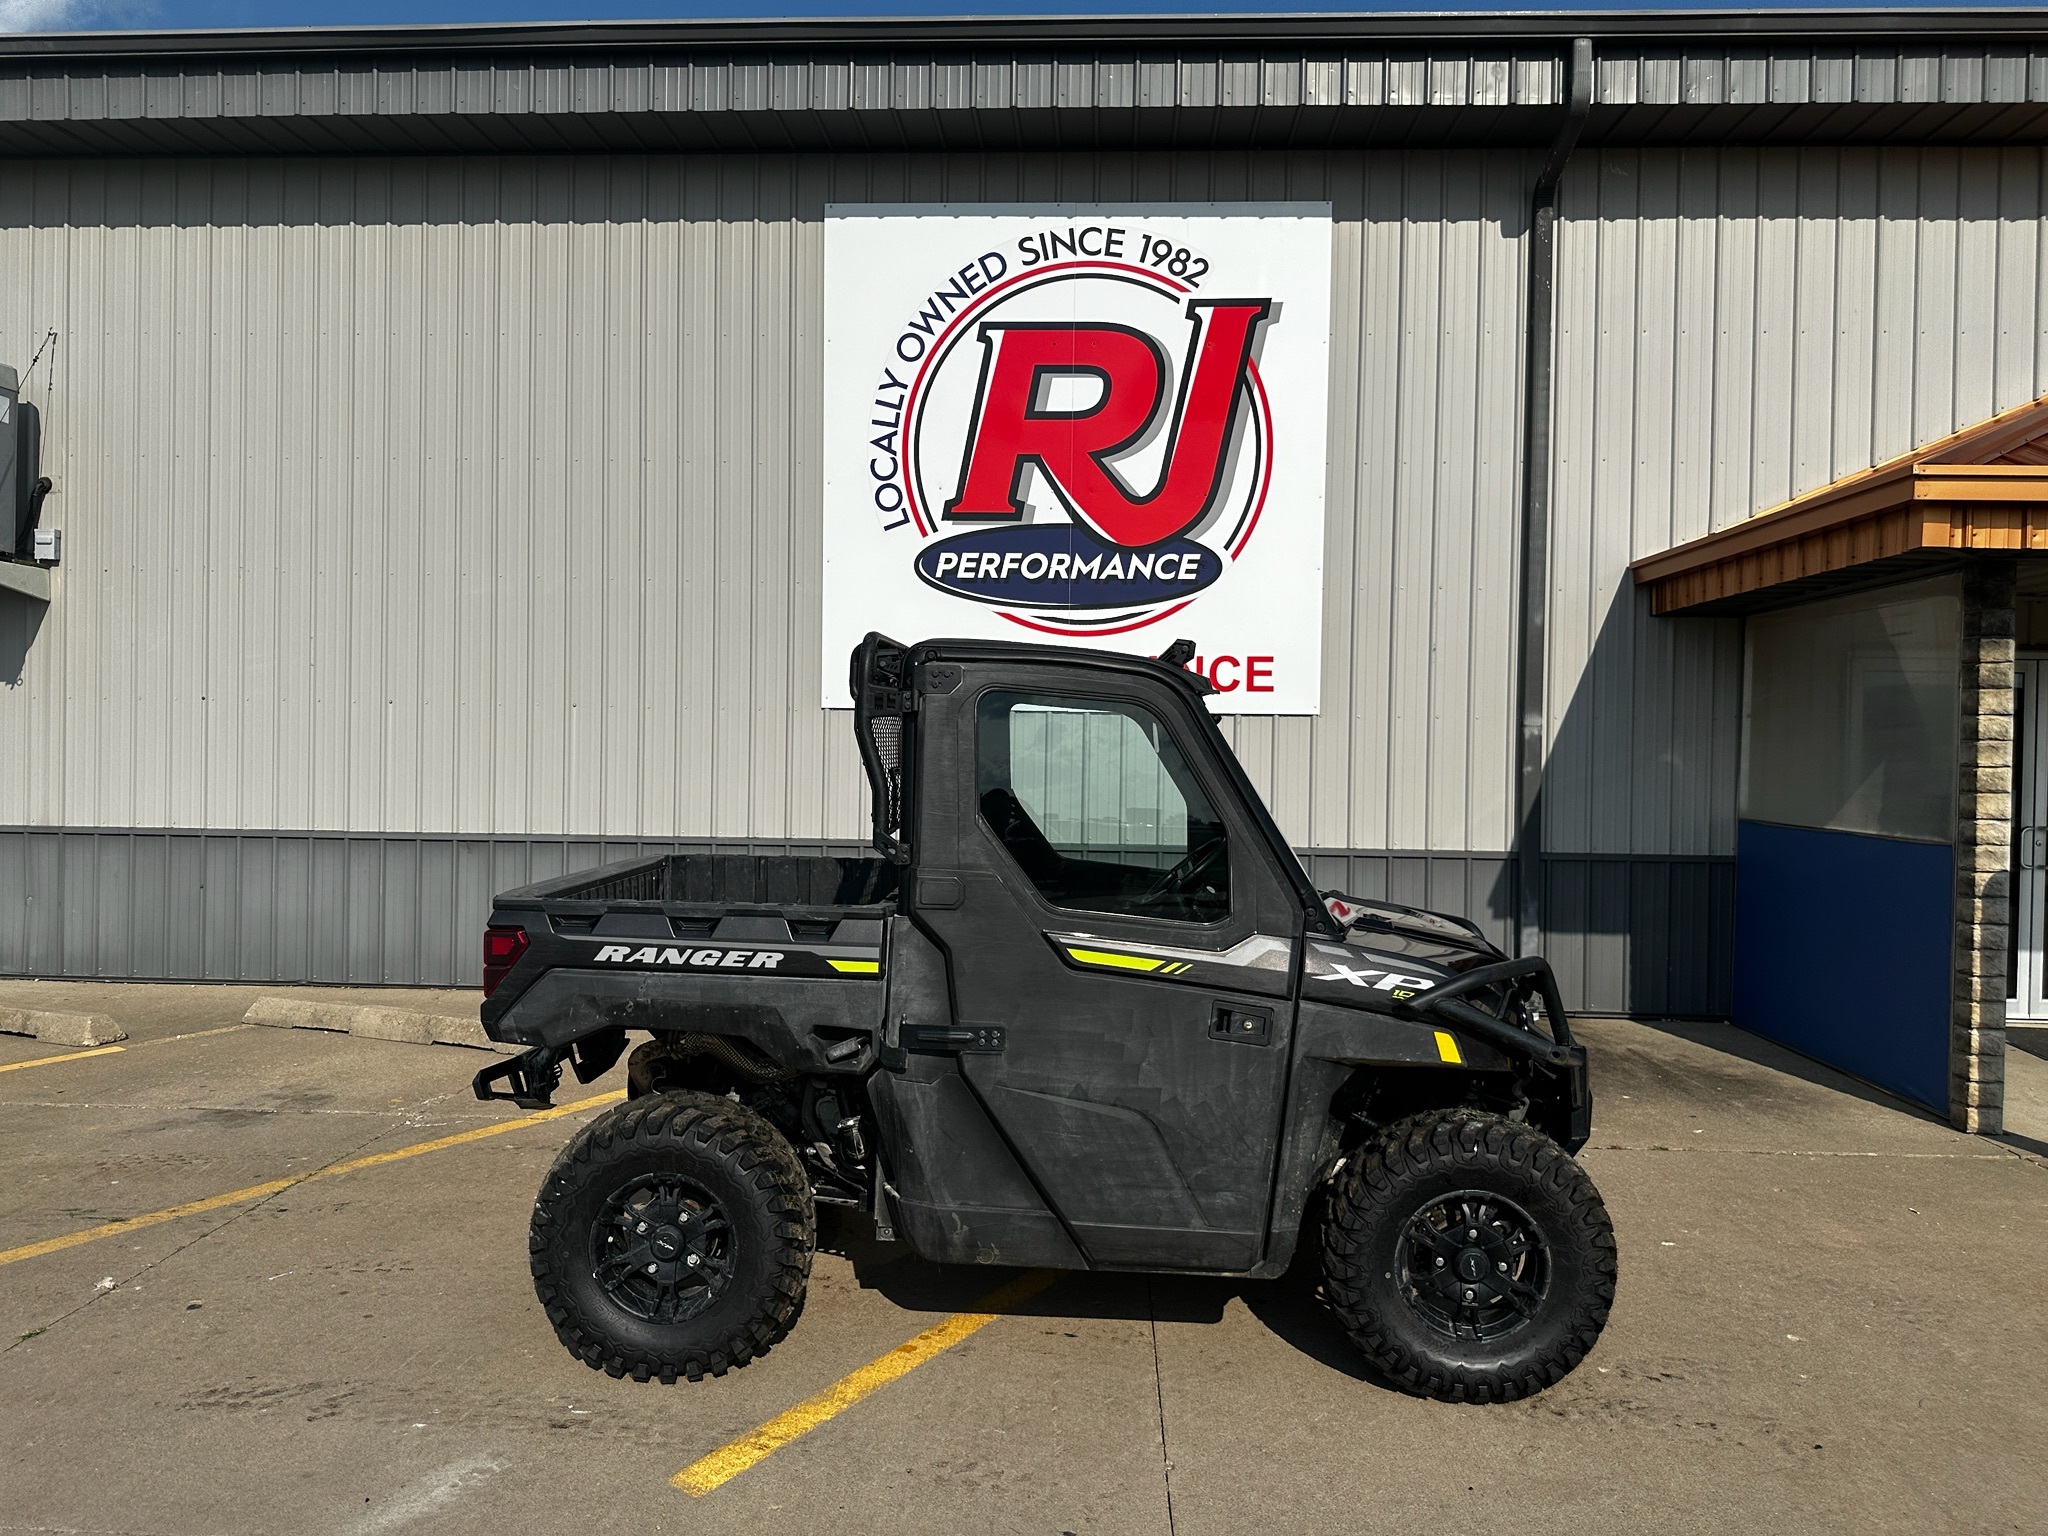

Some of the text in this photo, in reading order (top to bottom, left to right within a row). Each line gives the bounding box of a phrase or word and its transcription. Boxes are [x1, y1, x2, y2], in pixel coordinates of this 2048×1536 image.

[869, 226, 1210, 532] LOCALLY OWNED SINCE 1982
[942, 298, 1271, 549] RJ
[935, 552, 1202, 580] PERFORMANCE
[593, 945, 785, 969] RANGER
[1311, 962, 1436, 991] XP
